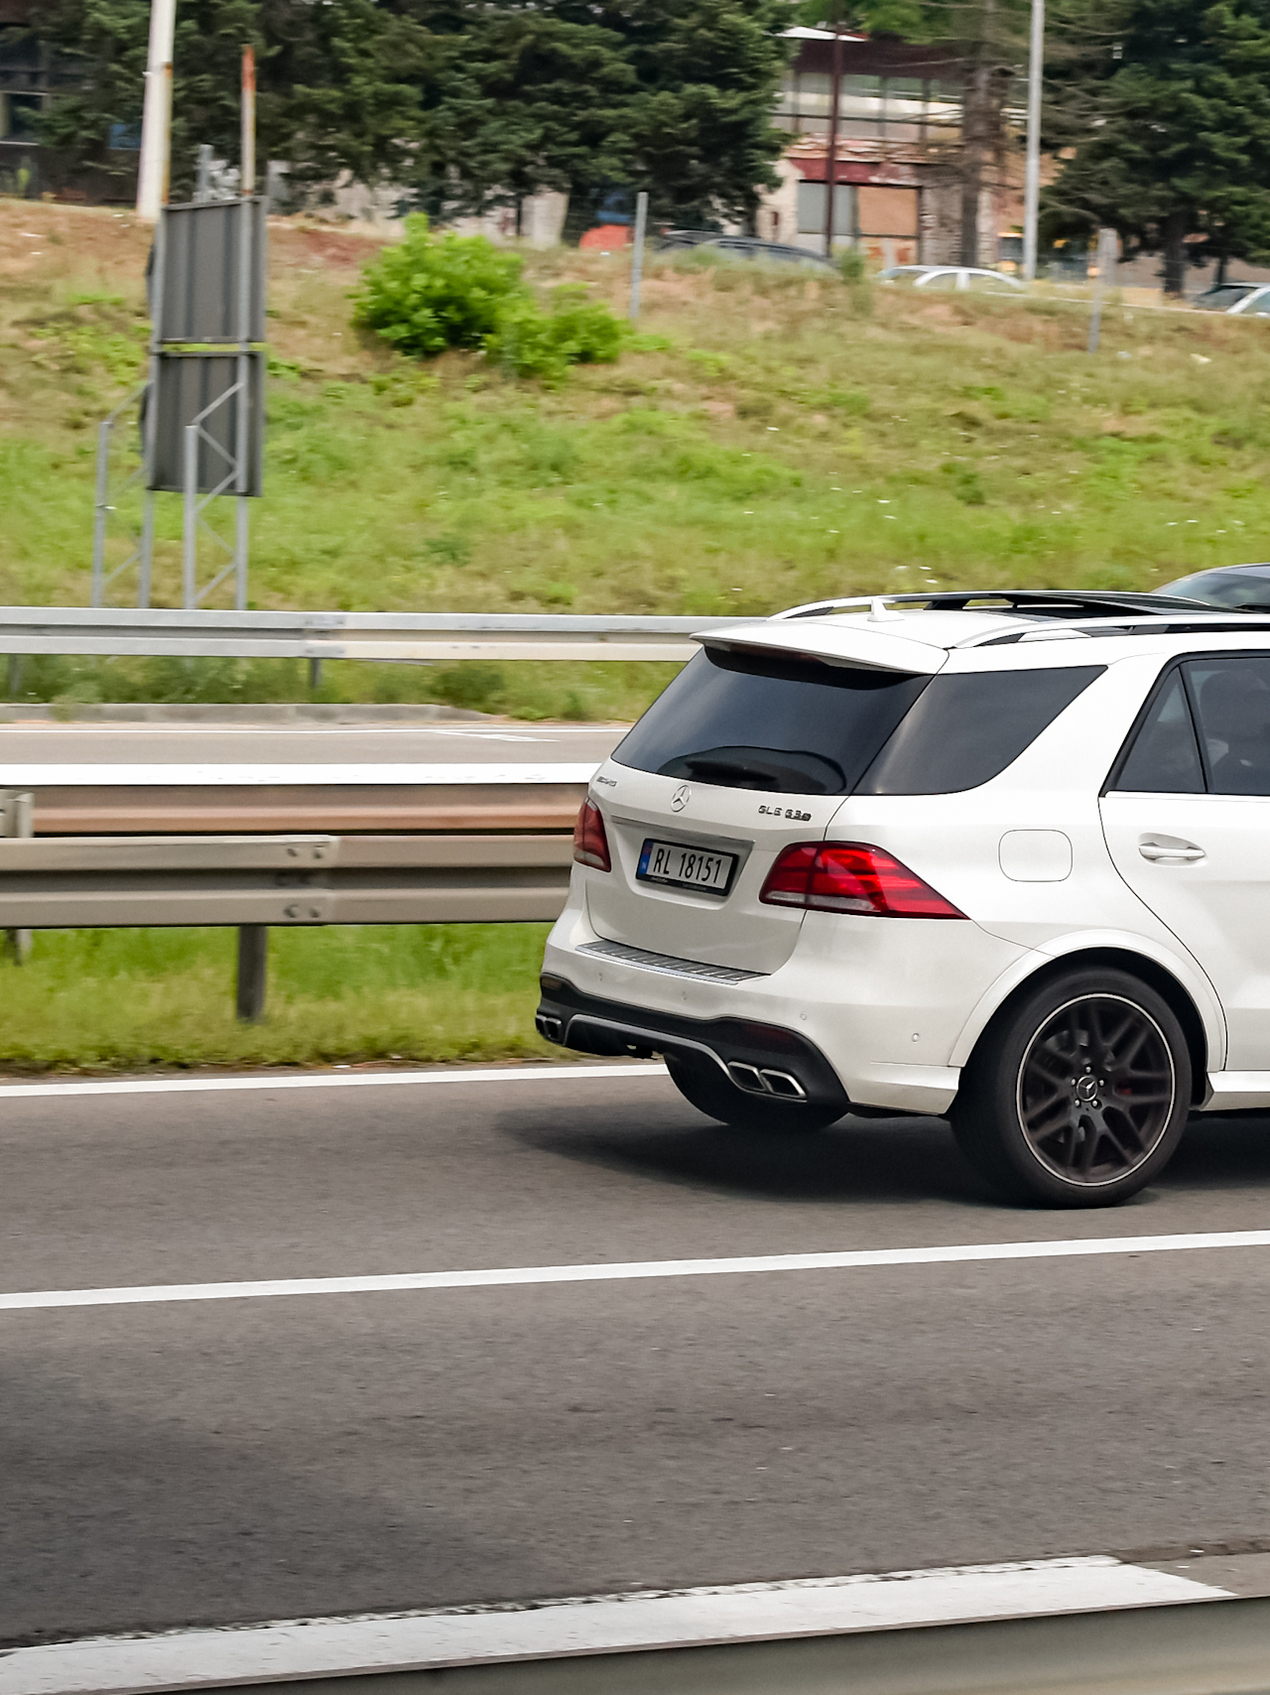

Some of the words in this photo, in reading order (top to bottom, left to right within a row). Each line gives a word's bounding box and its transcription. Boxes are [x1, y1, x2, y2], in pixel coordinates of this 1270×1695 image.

[758, 804, 782, 817] GLE
[653, 847, 672, 875] RL
[678, 852, 723, 884] 18151
